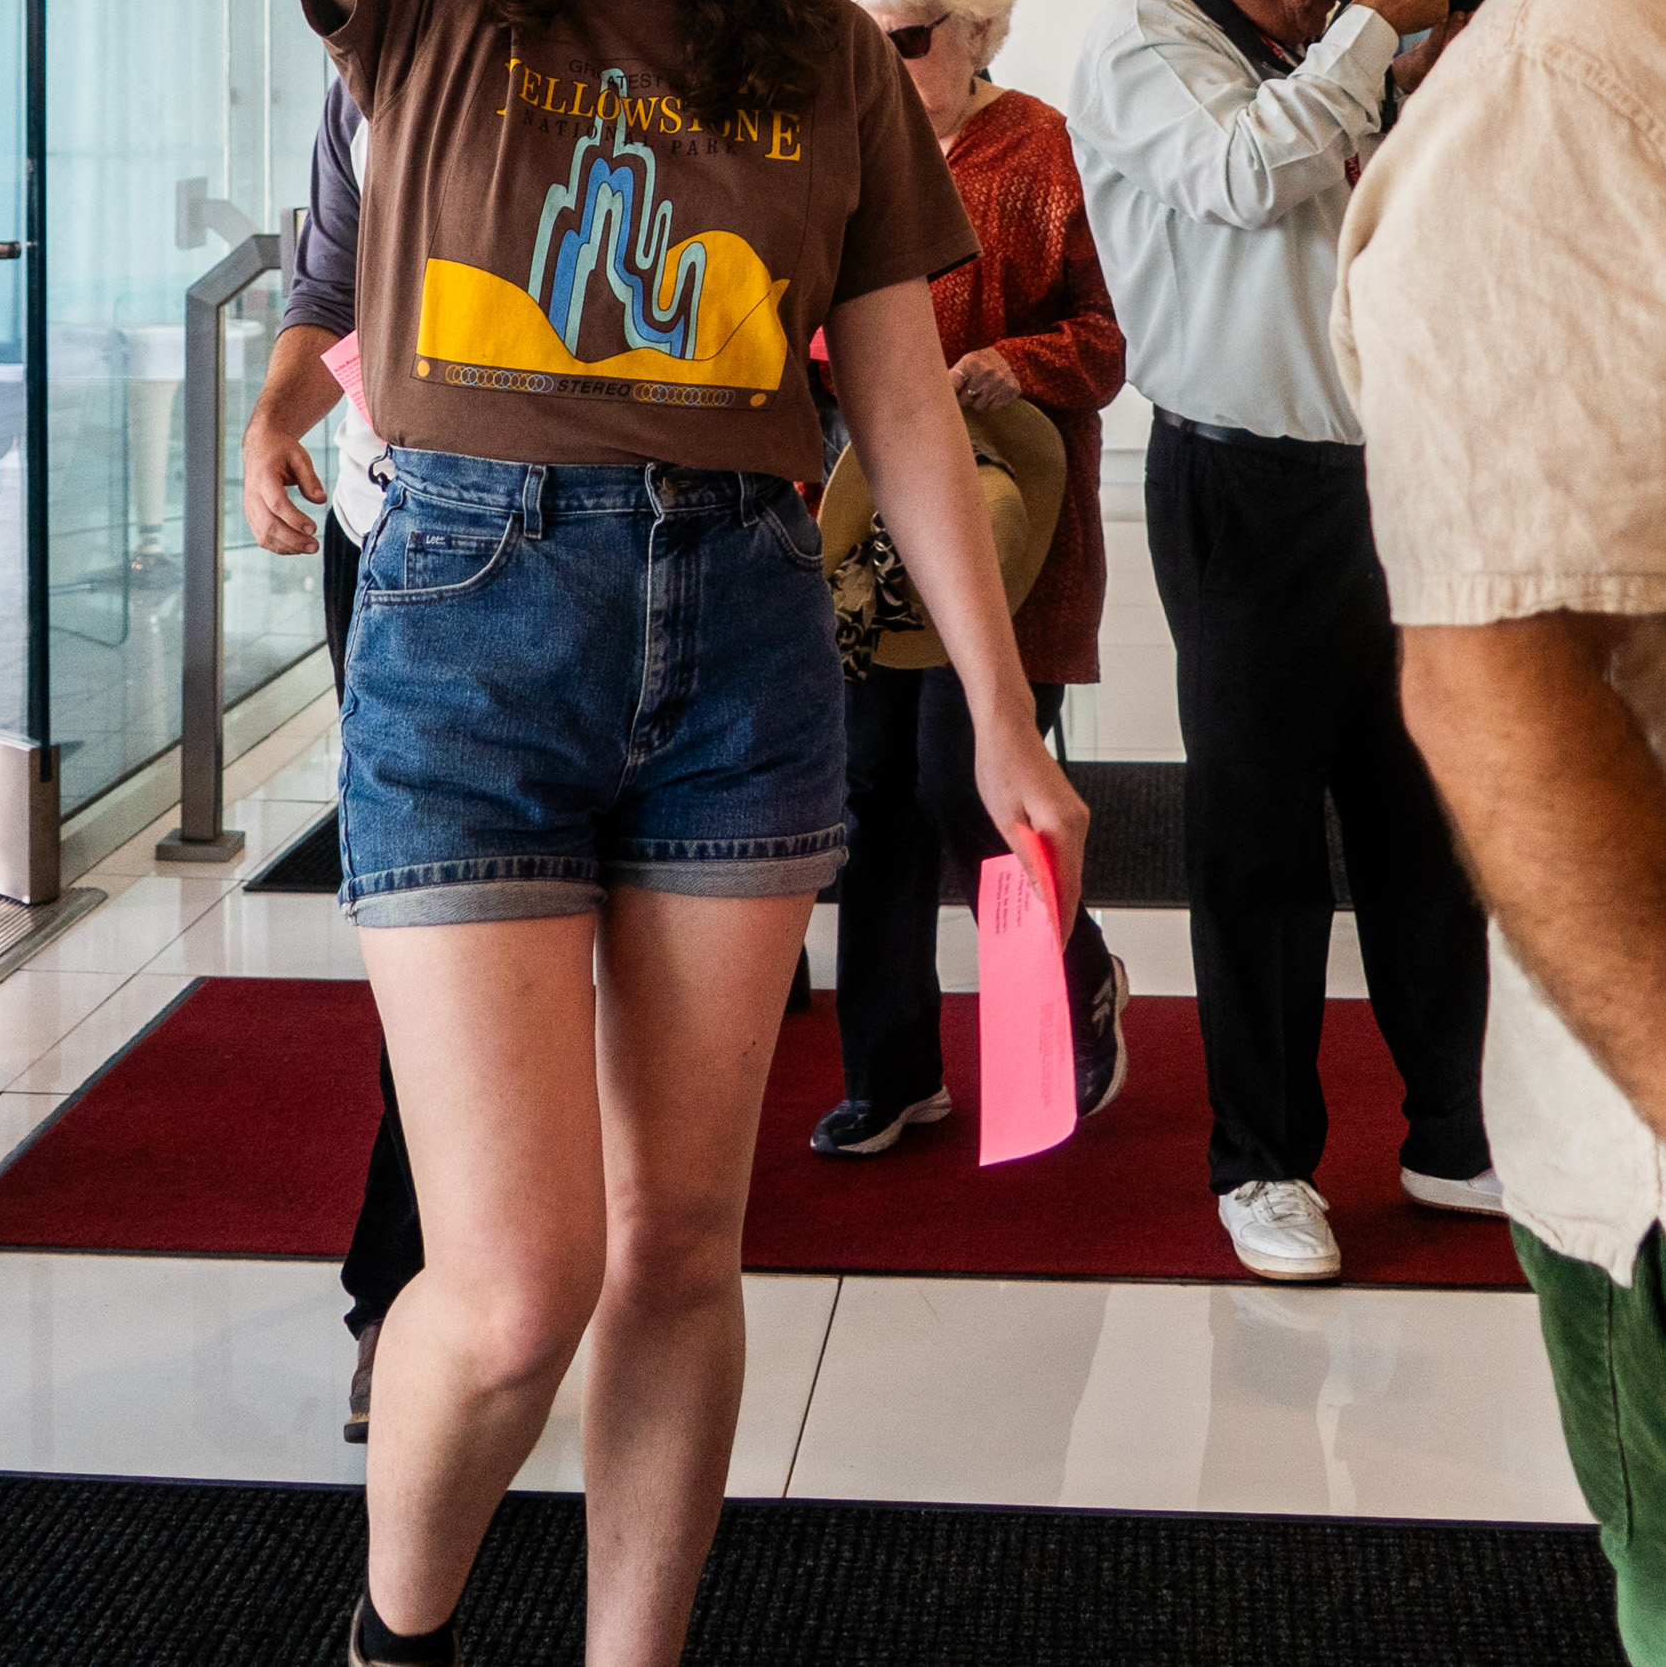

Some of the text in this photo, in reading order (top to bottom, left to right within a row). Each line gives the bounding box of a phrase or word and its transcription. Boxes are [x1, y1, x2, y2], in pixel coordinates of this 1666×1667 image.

[521, 109, 738, 157] NATIONAL PARK
[555, 378, 632, 398] STEREO
